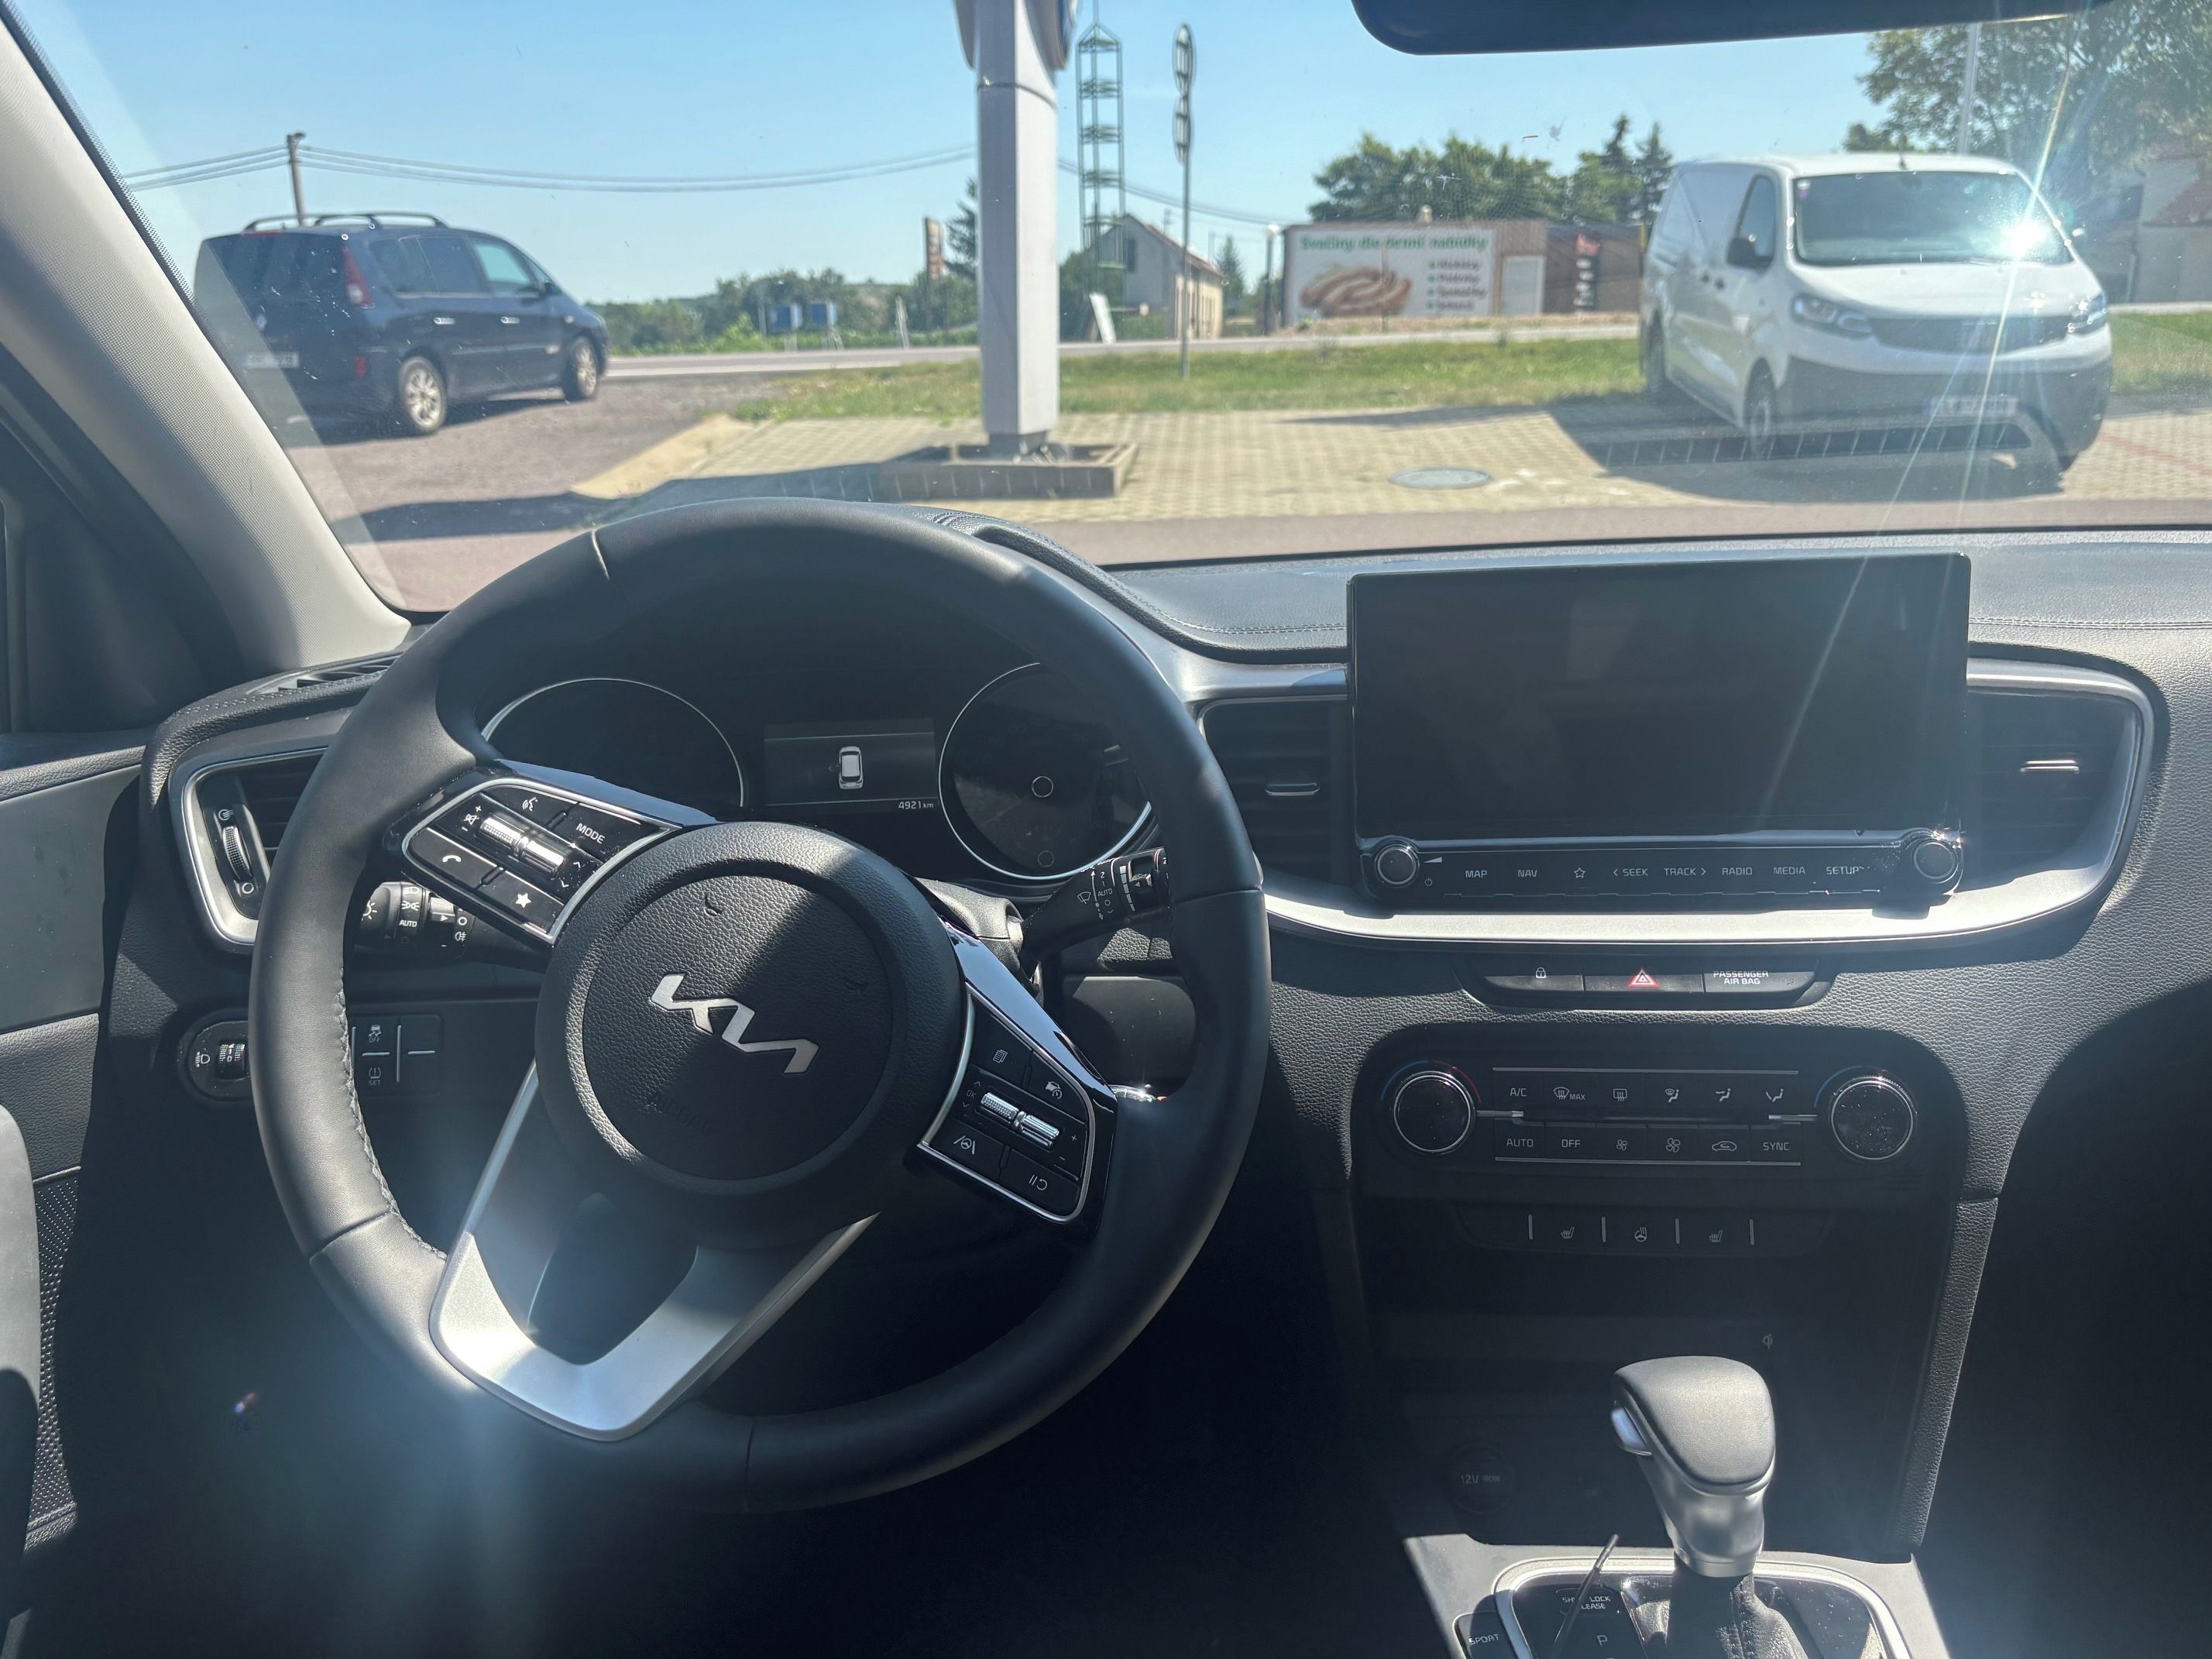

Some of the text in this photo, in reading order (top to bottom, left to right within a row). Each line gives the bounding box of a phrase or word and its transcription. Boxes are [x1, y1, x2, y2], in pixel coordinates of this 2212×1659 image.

[898, 801, 921, 809] 4921
[576, 822, 605, 844] MODE
[1465, 869, 1537, 878] MAP NAV
[1623, 868, 1648, 877] SEEK
[1664, 867, 1696, 876] TRACK
[1722, 867, 1753, 875] RADIO
[1774, 867, 1805, 875] MEDIA
[1826, 866, 1860, 875] SETUP
[1097, 888, 1113, 897] AUTO
[966, 1088, 976, 1100] OK
[1510, 1087, 1527, 1097] A/C
[1506, 1139, 1534, 1147] AUTO
[1561, 1139, 1581, 1148] OFF
[1763, 1142, 1790, 1151] SYNC
[1461, 1474, 1479, 1484] 12V
[1468, 1633, 1500, 1645] SPORT
[1596, 1634, 1609, 1647] P
